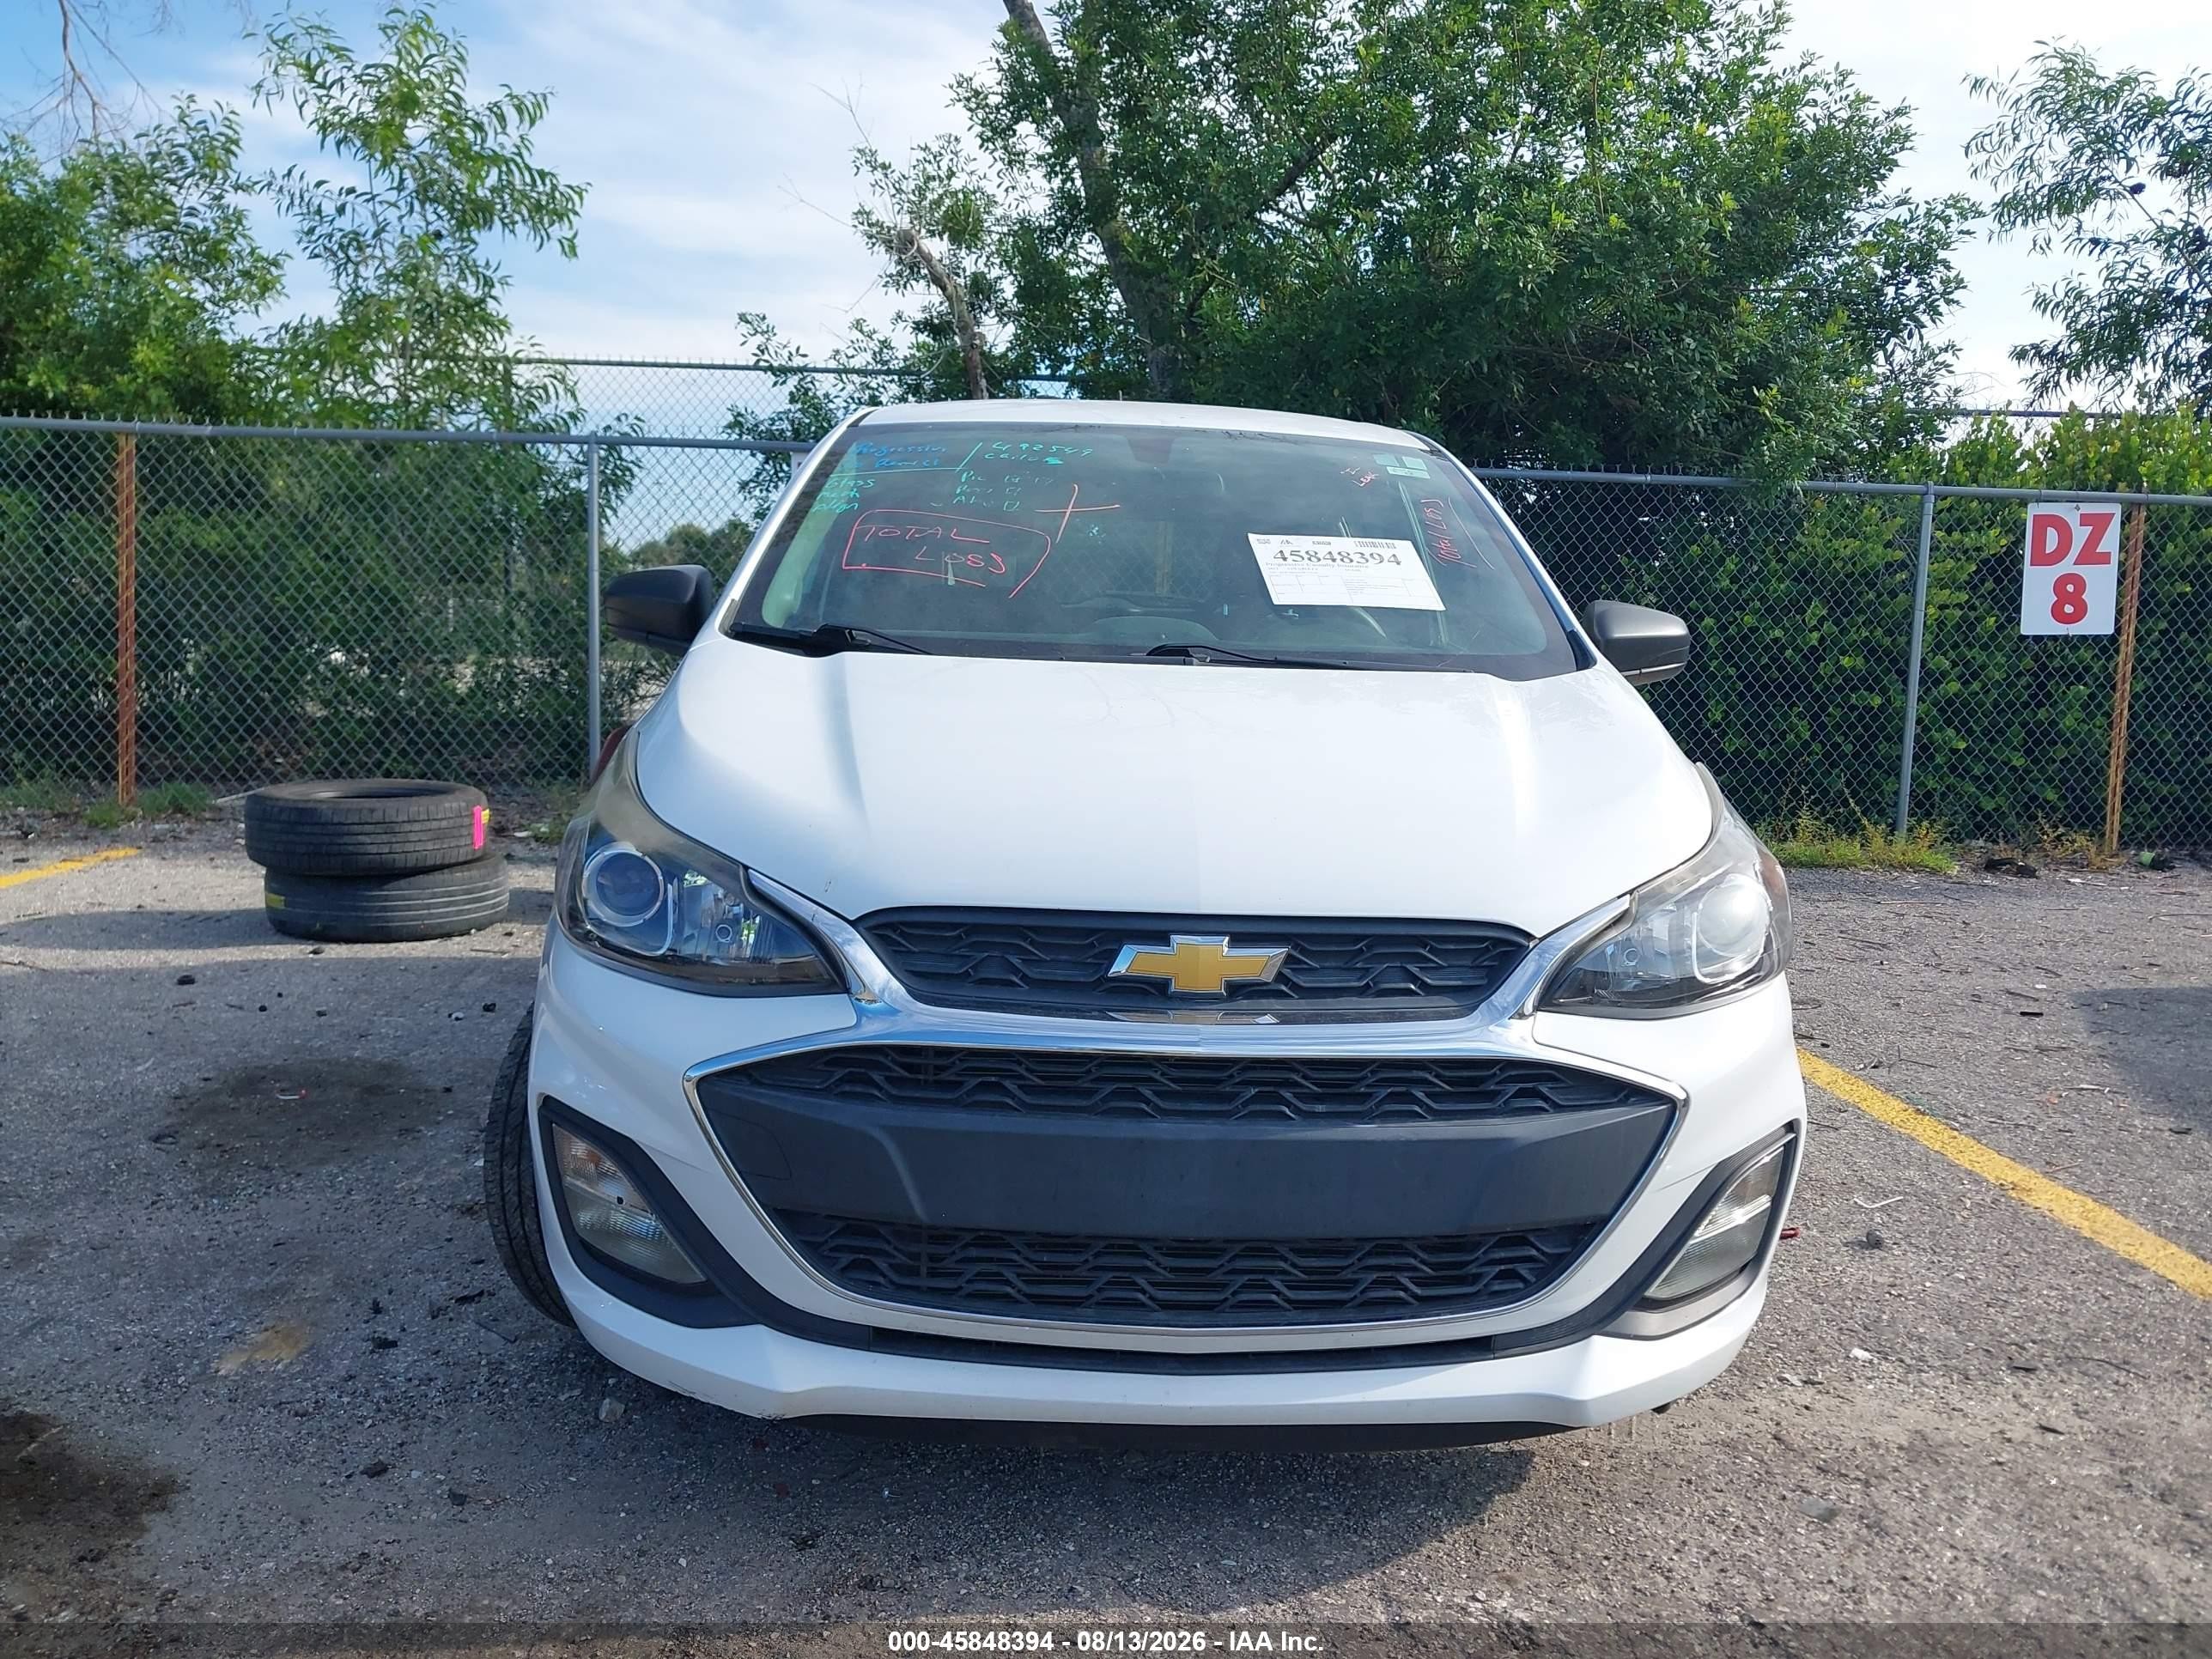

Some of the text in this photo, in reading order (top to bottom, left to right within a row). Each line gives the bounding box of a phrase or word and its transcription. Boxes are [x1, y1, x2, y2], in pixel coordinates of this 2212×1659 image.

[856, 524, 990, 544] TOTAL
[2029, 512, 2117, 567] DZ
[915, 546, 1006, 574] LOSS
[1273, 550, 1402, 566] 45848394
[2051, 572, 2088, 625] 8
